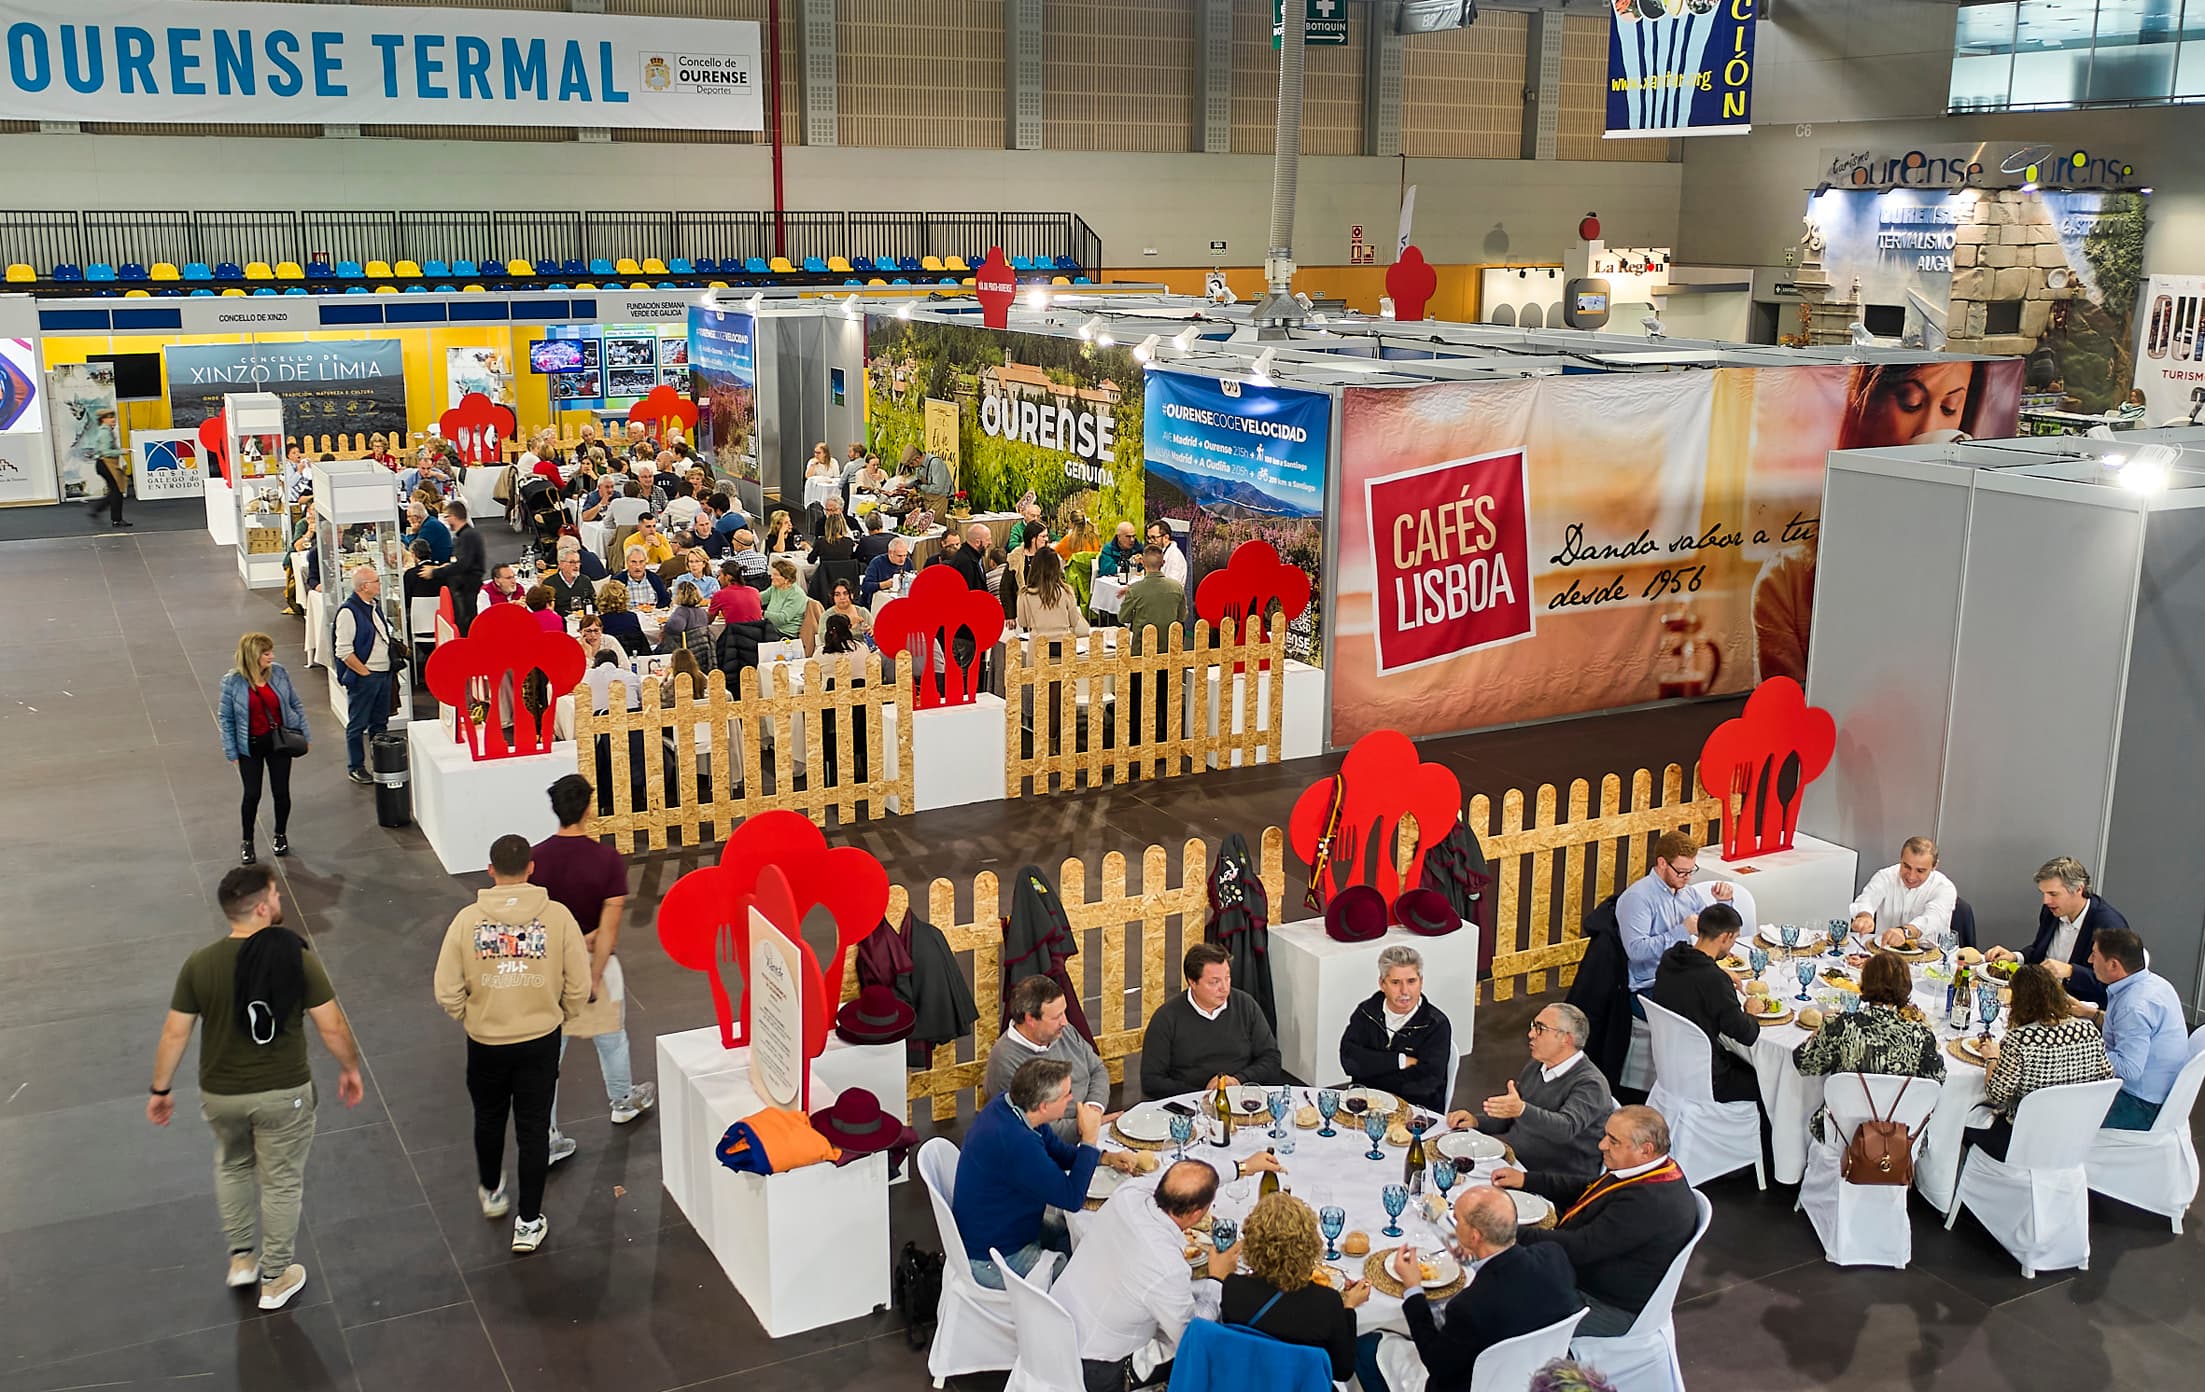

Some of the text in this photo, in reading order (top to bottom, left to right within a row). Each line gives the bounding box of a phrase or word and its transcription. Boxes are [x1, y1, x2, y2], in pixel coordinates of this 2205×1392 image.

[7, 22, 629, 103] OURENSE TERMAL
[679, 56, 737, 68] Concello de
[680, 69, 747, 84] OURENSE
[1611, 70, 1712, 92] www.xantar.org
[696, 85, 731, 95] Deportes
[1795, 124, 1812, 137] C6
[1832, 151, 1869, 174] turismo
[1851, 150, 1983, 185] ourense
[1877, 231, 1956, 250] TERMALISMO
[1594, 260, 1614, 273] La
[1917, 255, 1953, 272] AUGA
[626, 301, 685, 310] FUNDACIÓN SEMANA
[631, 310, 650, 318] VERDE
[659, 309, 682, 317] GALICIA
[219, 313, 288, 322] CONCELLO DE XINZO
[240, 353, 338, 364] CONCELLO DE
[190, 361, 382, 385] XINZO DE LIMIA
[2162, 369, 2205, 381] TURISM
[981, 395, 1115, 463] OURENSE
[1162, 402, 1307, 443] #OURENSECOGEVELOCIDAD
[1173, 434, 1197, 447] Madrid
[1204, 440, 1232, 455] Ourense
[1284, 459, 1308, 472] Santiago
[147, 476, 186, 484] GALEGO
[1065, 460, 1115, 487] GENUINA
[1171, 452, 1193, 465] Madrid
[1199, 457, 1206, 468] A
[1206, 458, 1231, 473] Gudiña
[1277, 477, 1287, 486] km
[1292, 480, 1316, 493] Santiago
[148, 482, 200, 490] ENTROIDO
[1393, 484, 1497, 570] CAFÉS
[1550, 511, 1821, 567] Dando sabor a tu
[1395, 552, 1517, 632] LISBOA
[1549, 564, 1707, 611] desde 1956
[497, 961, 528, 974] ナルト
